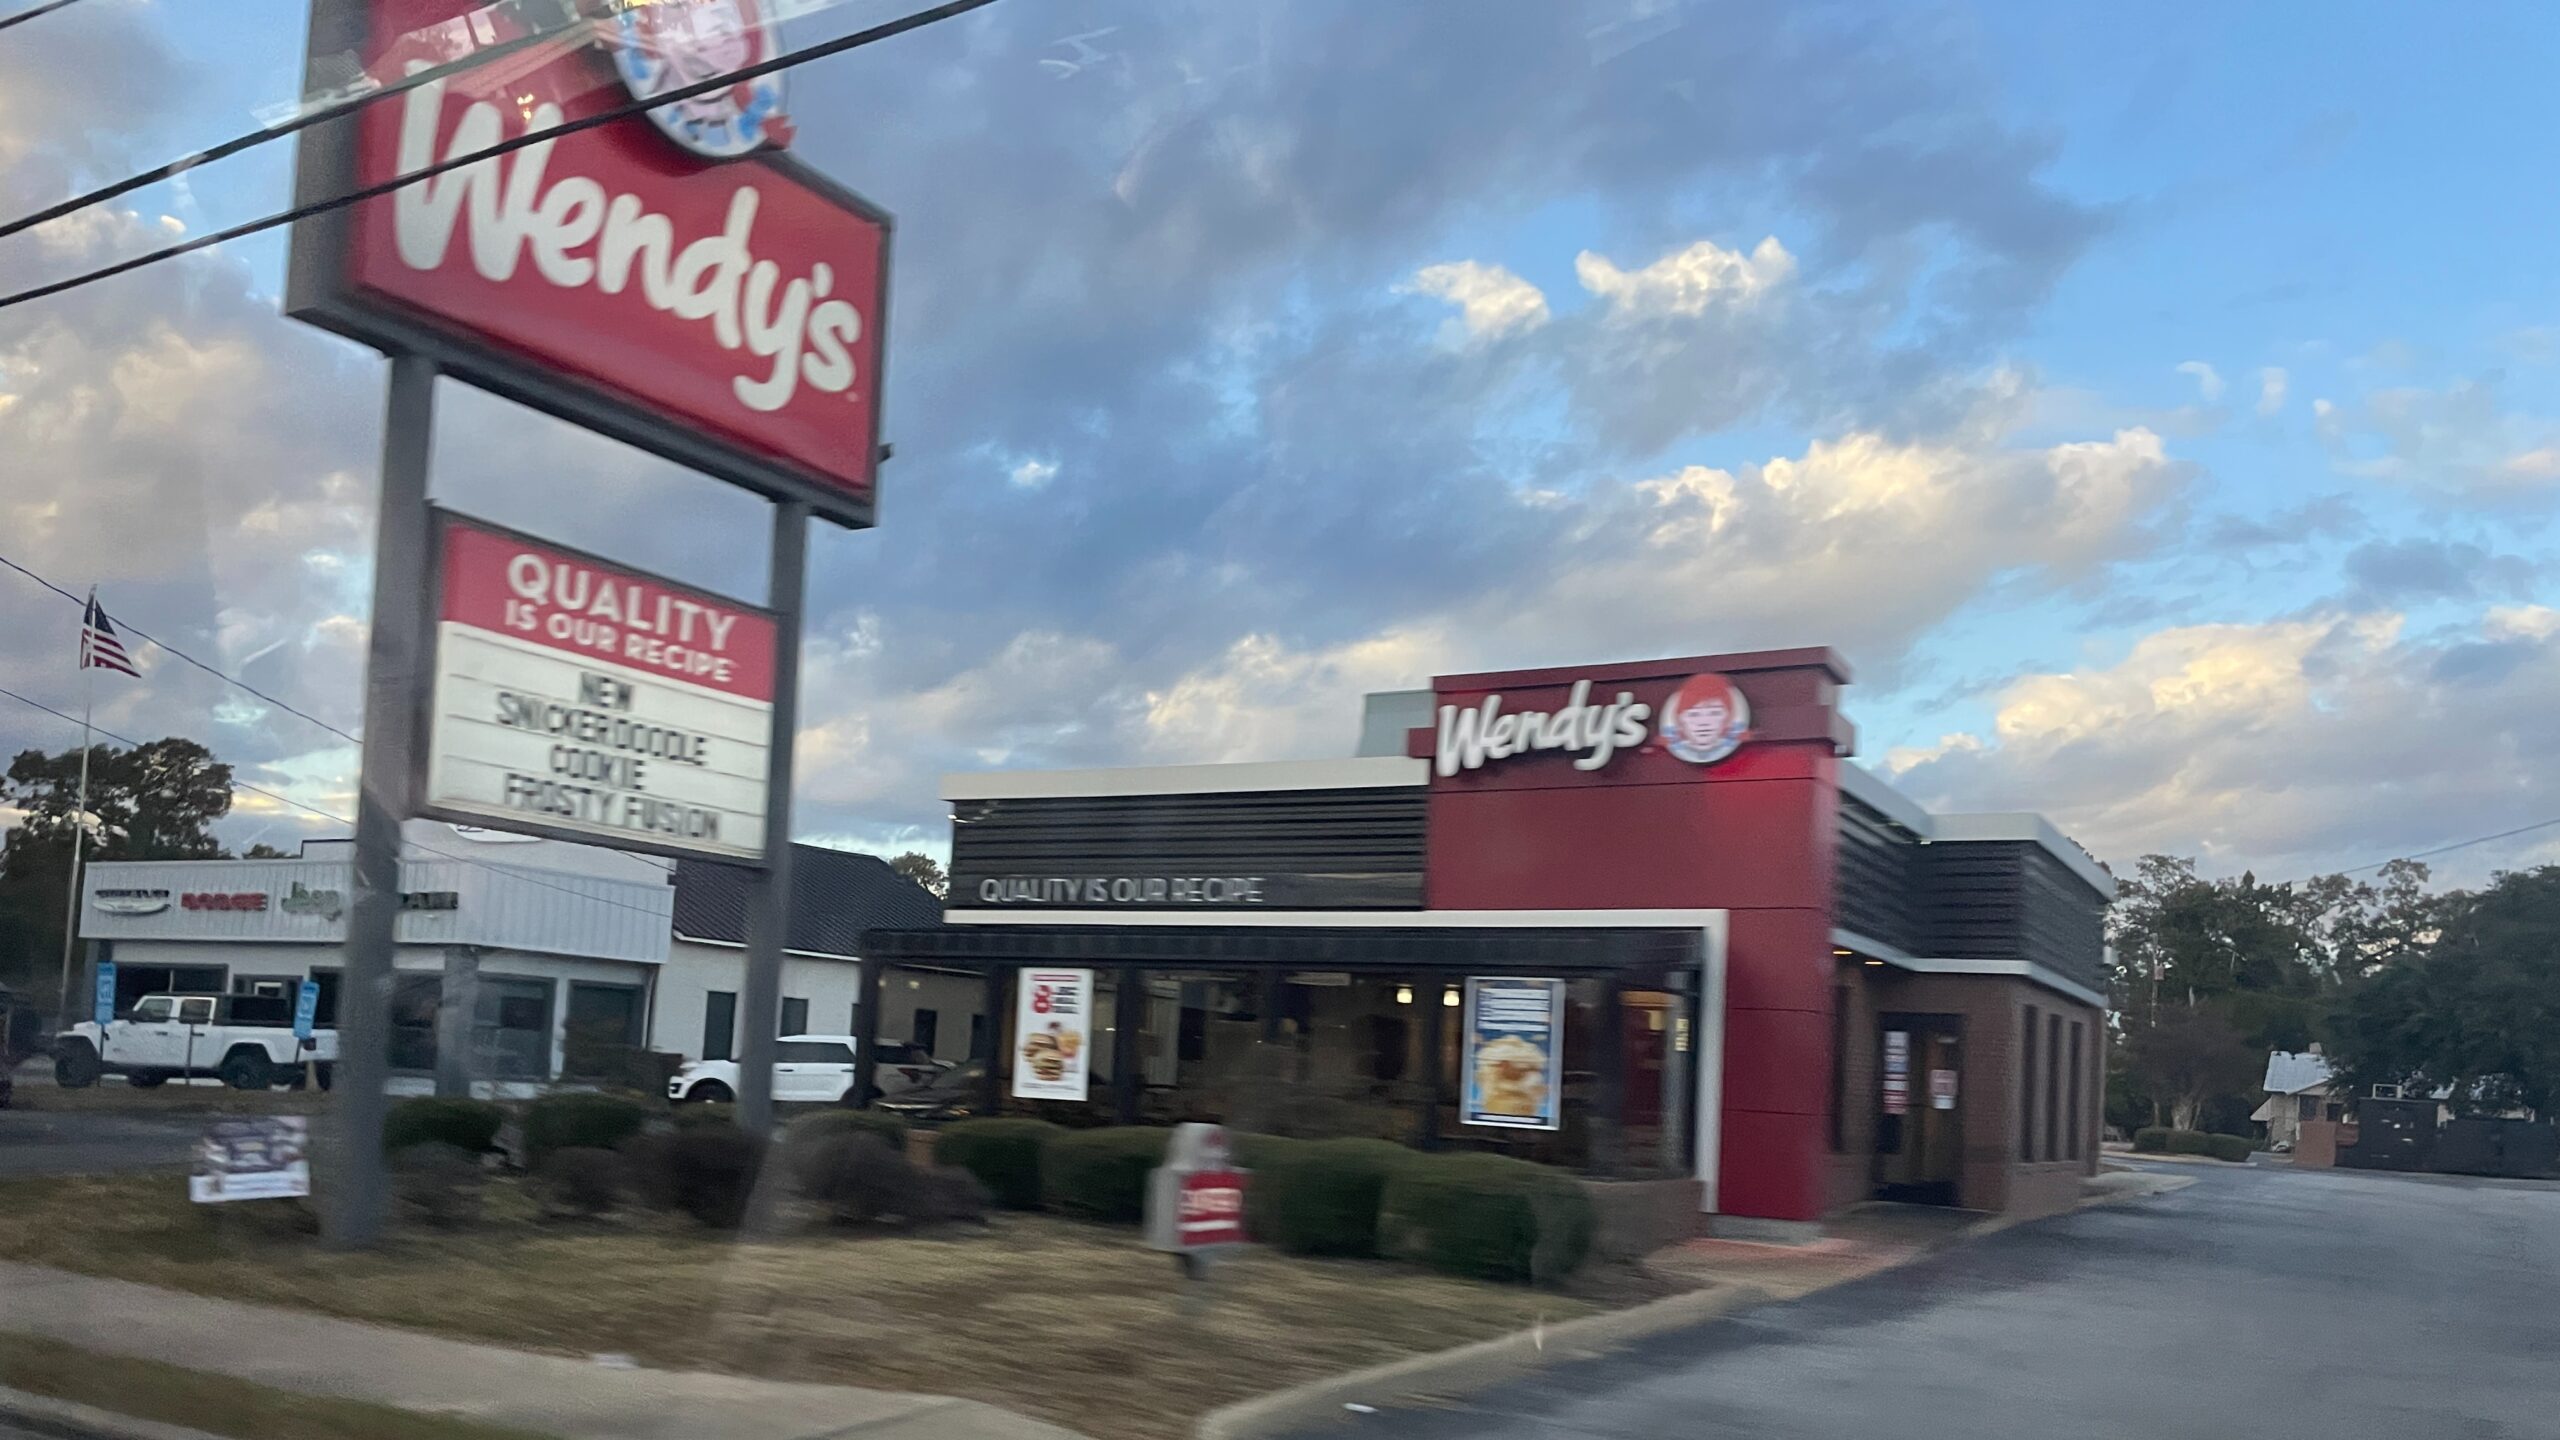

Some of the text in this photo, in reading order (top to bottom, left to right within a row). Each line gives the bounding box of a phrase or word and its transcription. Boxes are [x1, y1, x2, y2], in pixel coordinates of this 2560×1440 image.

[394, 60, 862, 411] Wendy's
[507, 553, 737, 650] QUALITY
[505, 600, 735, 682] IS OUR RECIPE
[497, 691, 707, 766] SNICKERDOODLE
[580, 672, 634, 711] NEW
[1436, 679, 1650, 777] Wendy's
[551, 744, 644, 790] COOKIE
[504, 773, 720, 839] FROSTY FUSION
[979, 877, 1265, 902] QUALITY IS OUR RECIPE
